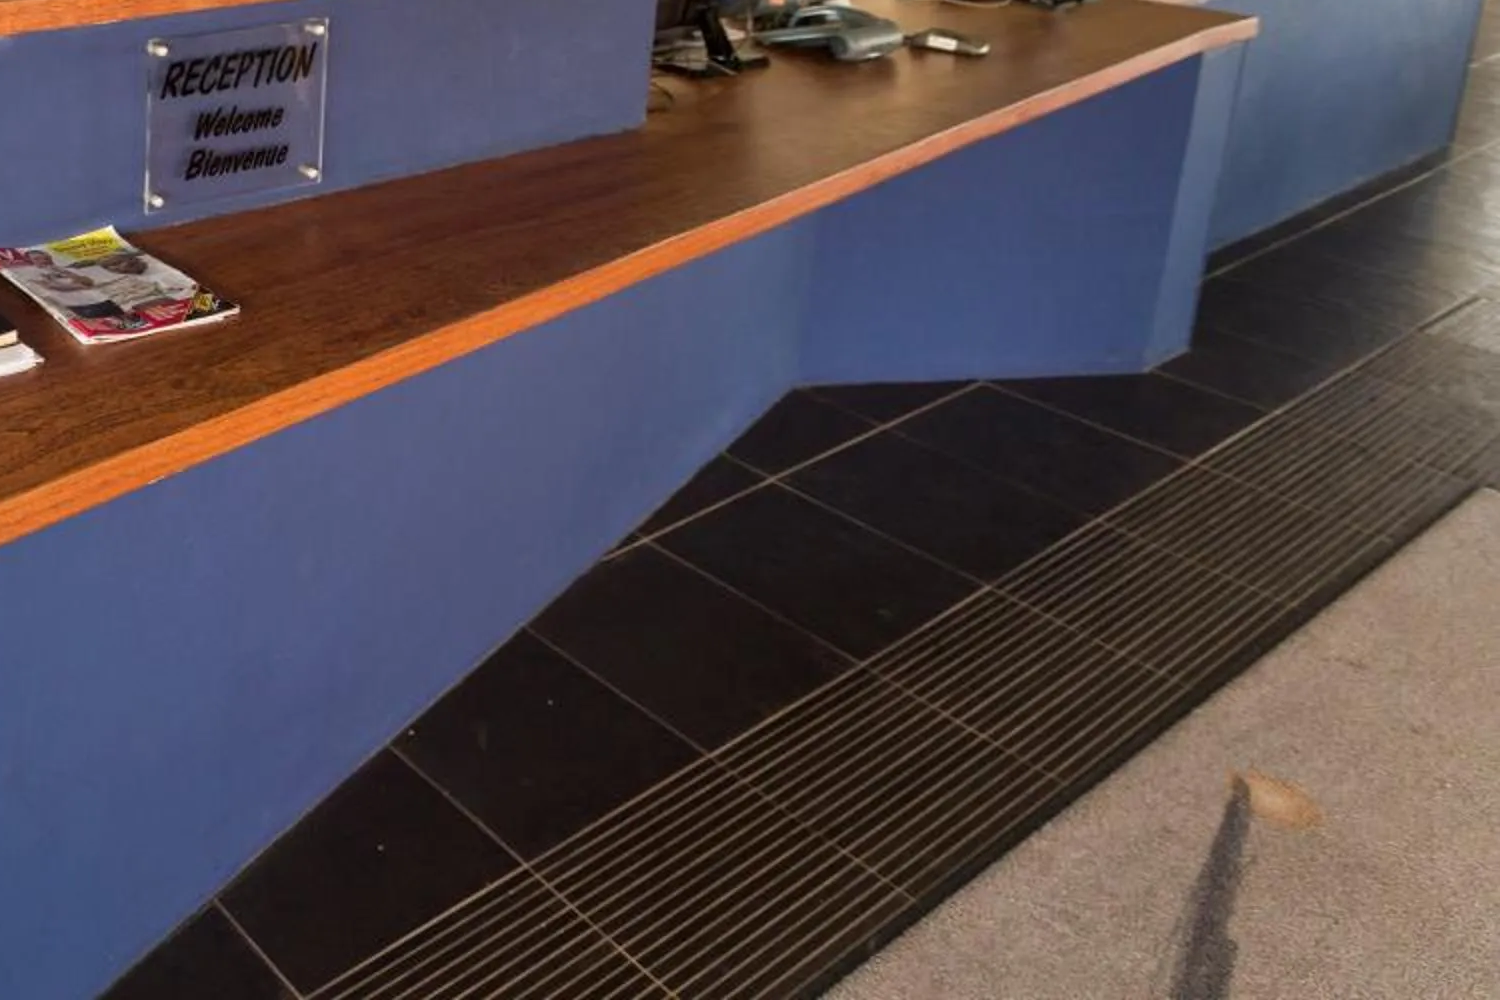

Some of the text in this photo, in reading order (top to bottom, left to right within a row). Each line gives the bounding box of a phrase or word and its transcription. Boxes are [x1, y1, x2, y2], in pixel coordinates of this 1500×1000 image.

[160, 41, 318, 100] RECEPTION
[194, 105, 284, 141] Welcome
[184, 143, 289, 180] Bienvenue
